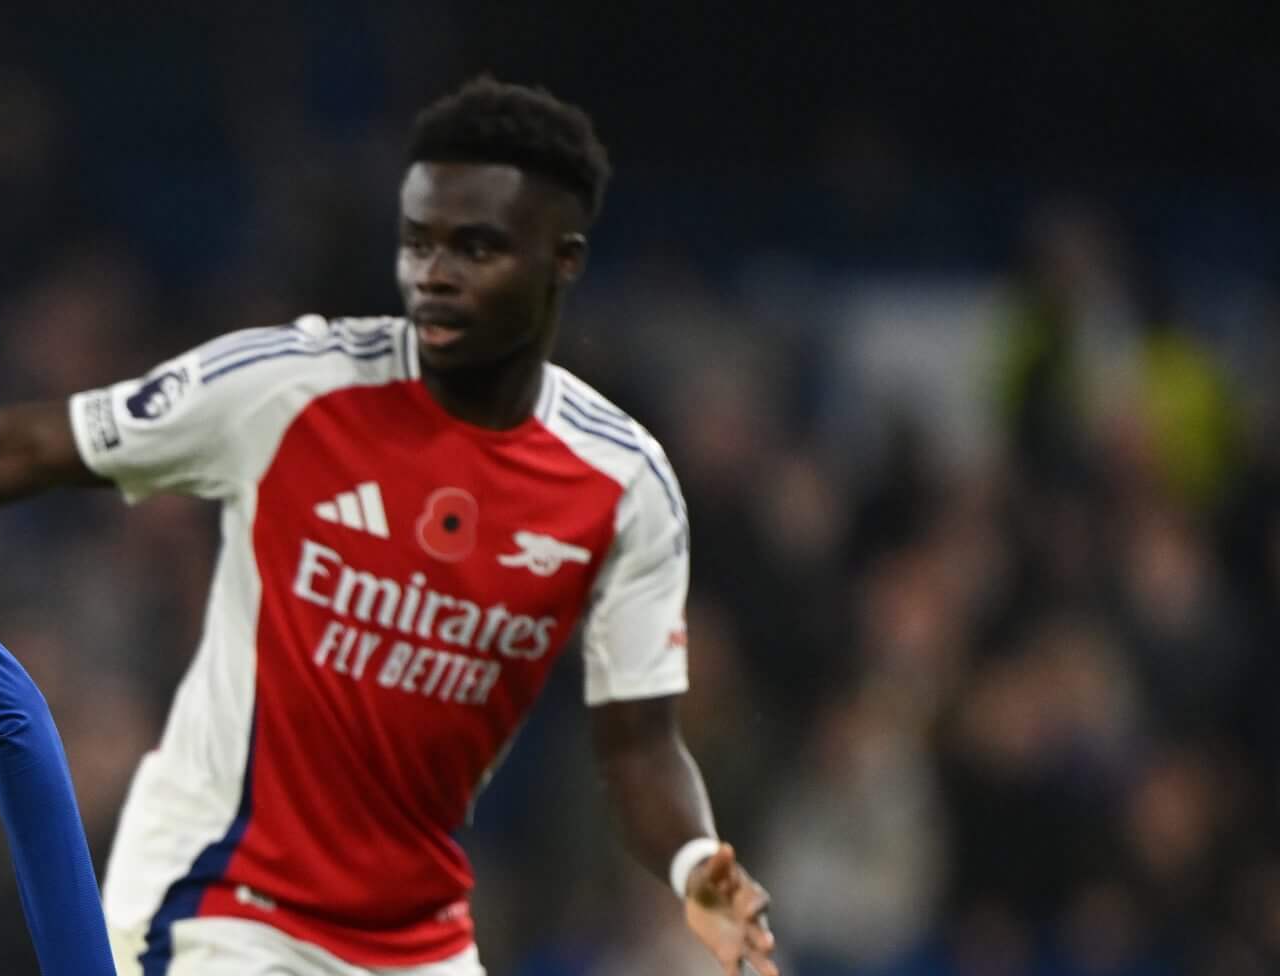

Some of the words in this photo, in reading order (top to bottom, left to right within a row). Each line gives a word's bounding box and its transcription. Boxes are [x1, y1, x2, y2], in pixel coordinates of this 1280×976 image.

[293, 539, 557, 660] Emirates
[313, 620, 380, 681] FLY
[376, 641, 502, 704] BETTER
